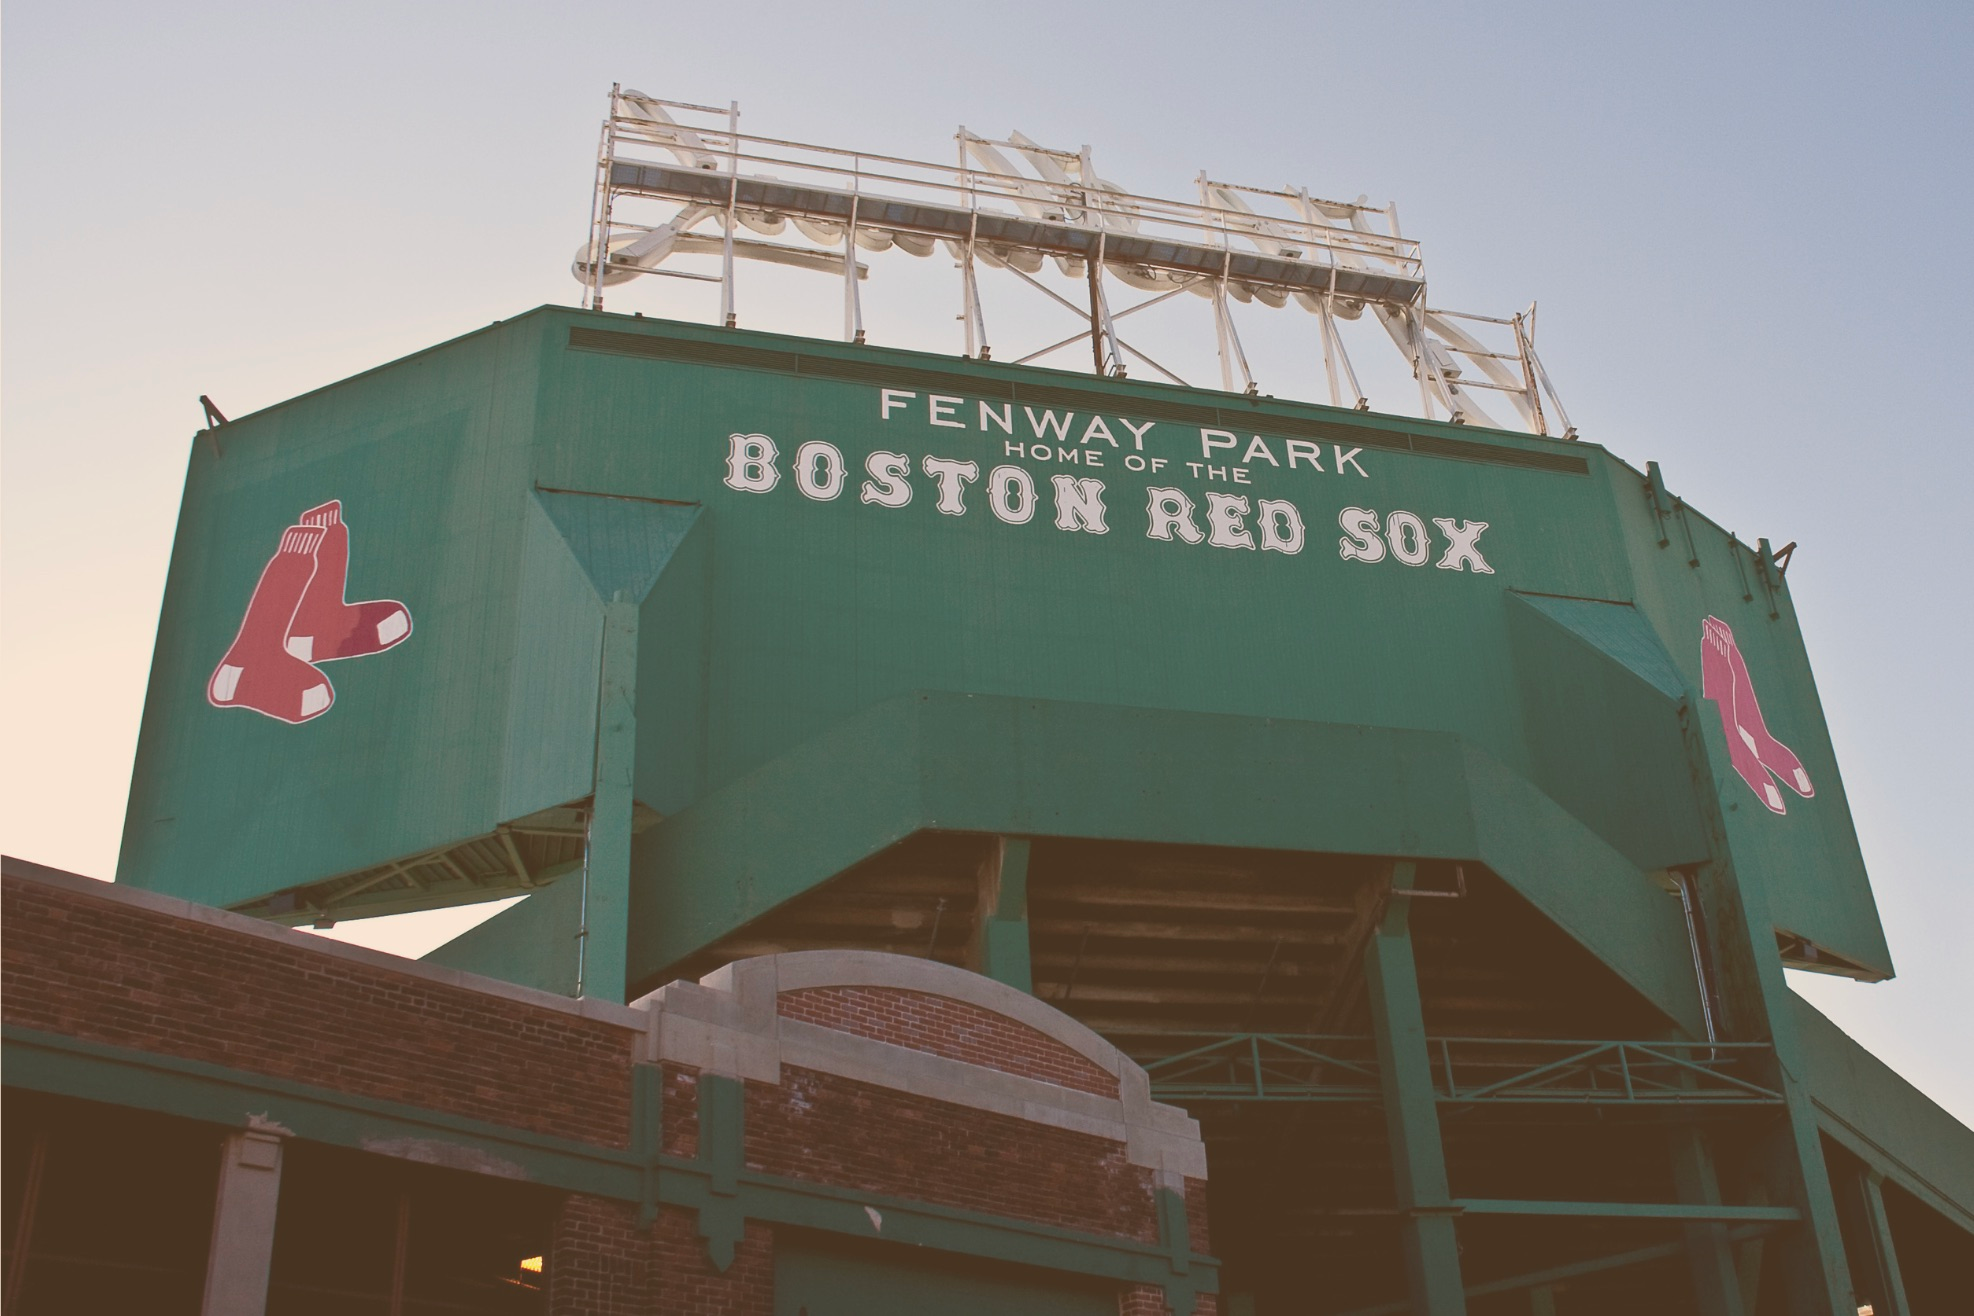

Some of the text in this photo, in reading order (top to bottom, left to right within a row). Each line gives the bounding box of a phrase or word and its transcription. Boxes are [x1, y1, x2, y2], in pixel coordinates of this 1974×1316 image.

[881, 388, 1370, 478] FENWAY PARK
[1004, 440, 1252, 485] HOME OF THE
[724, 432, 1496, 575] BOSTON RED SOX
